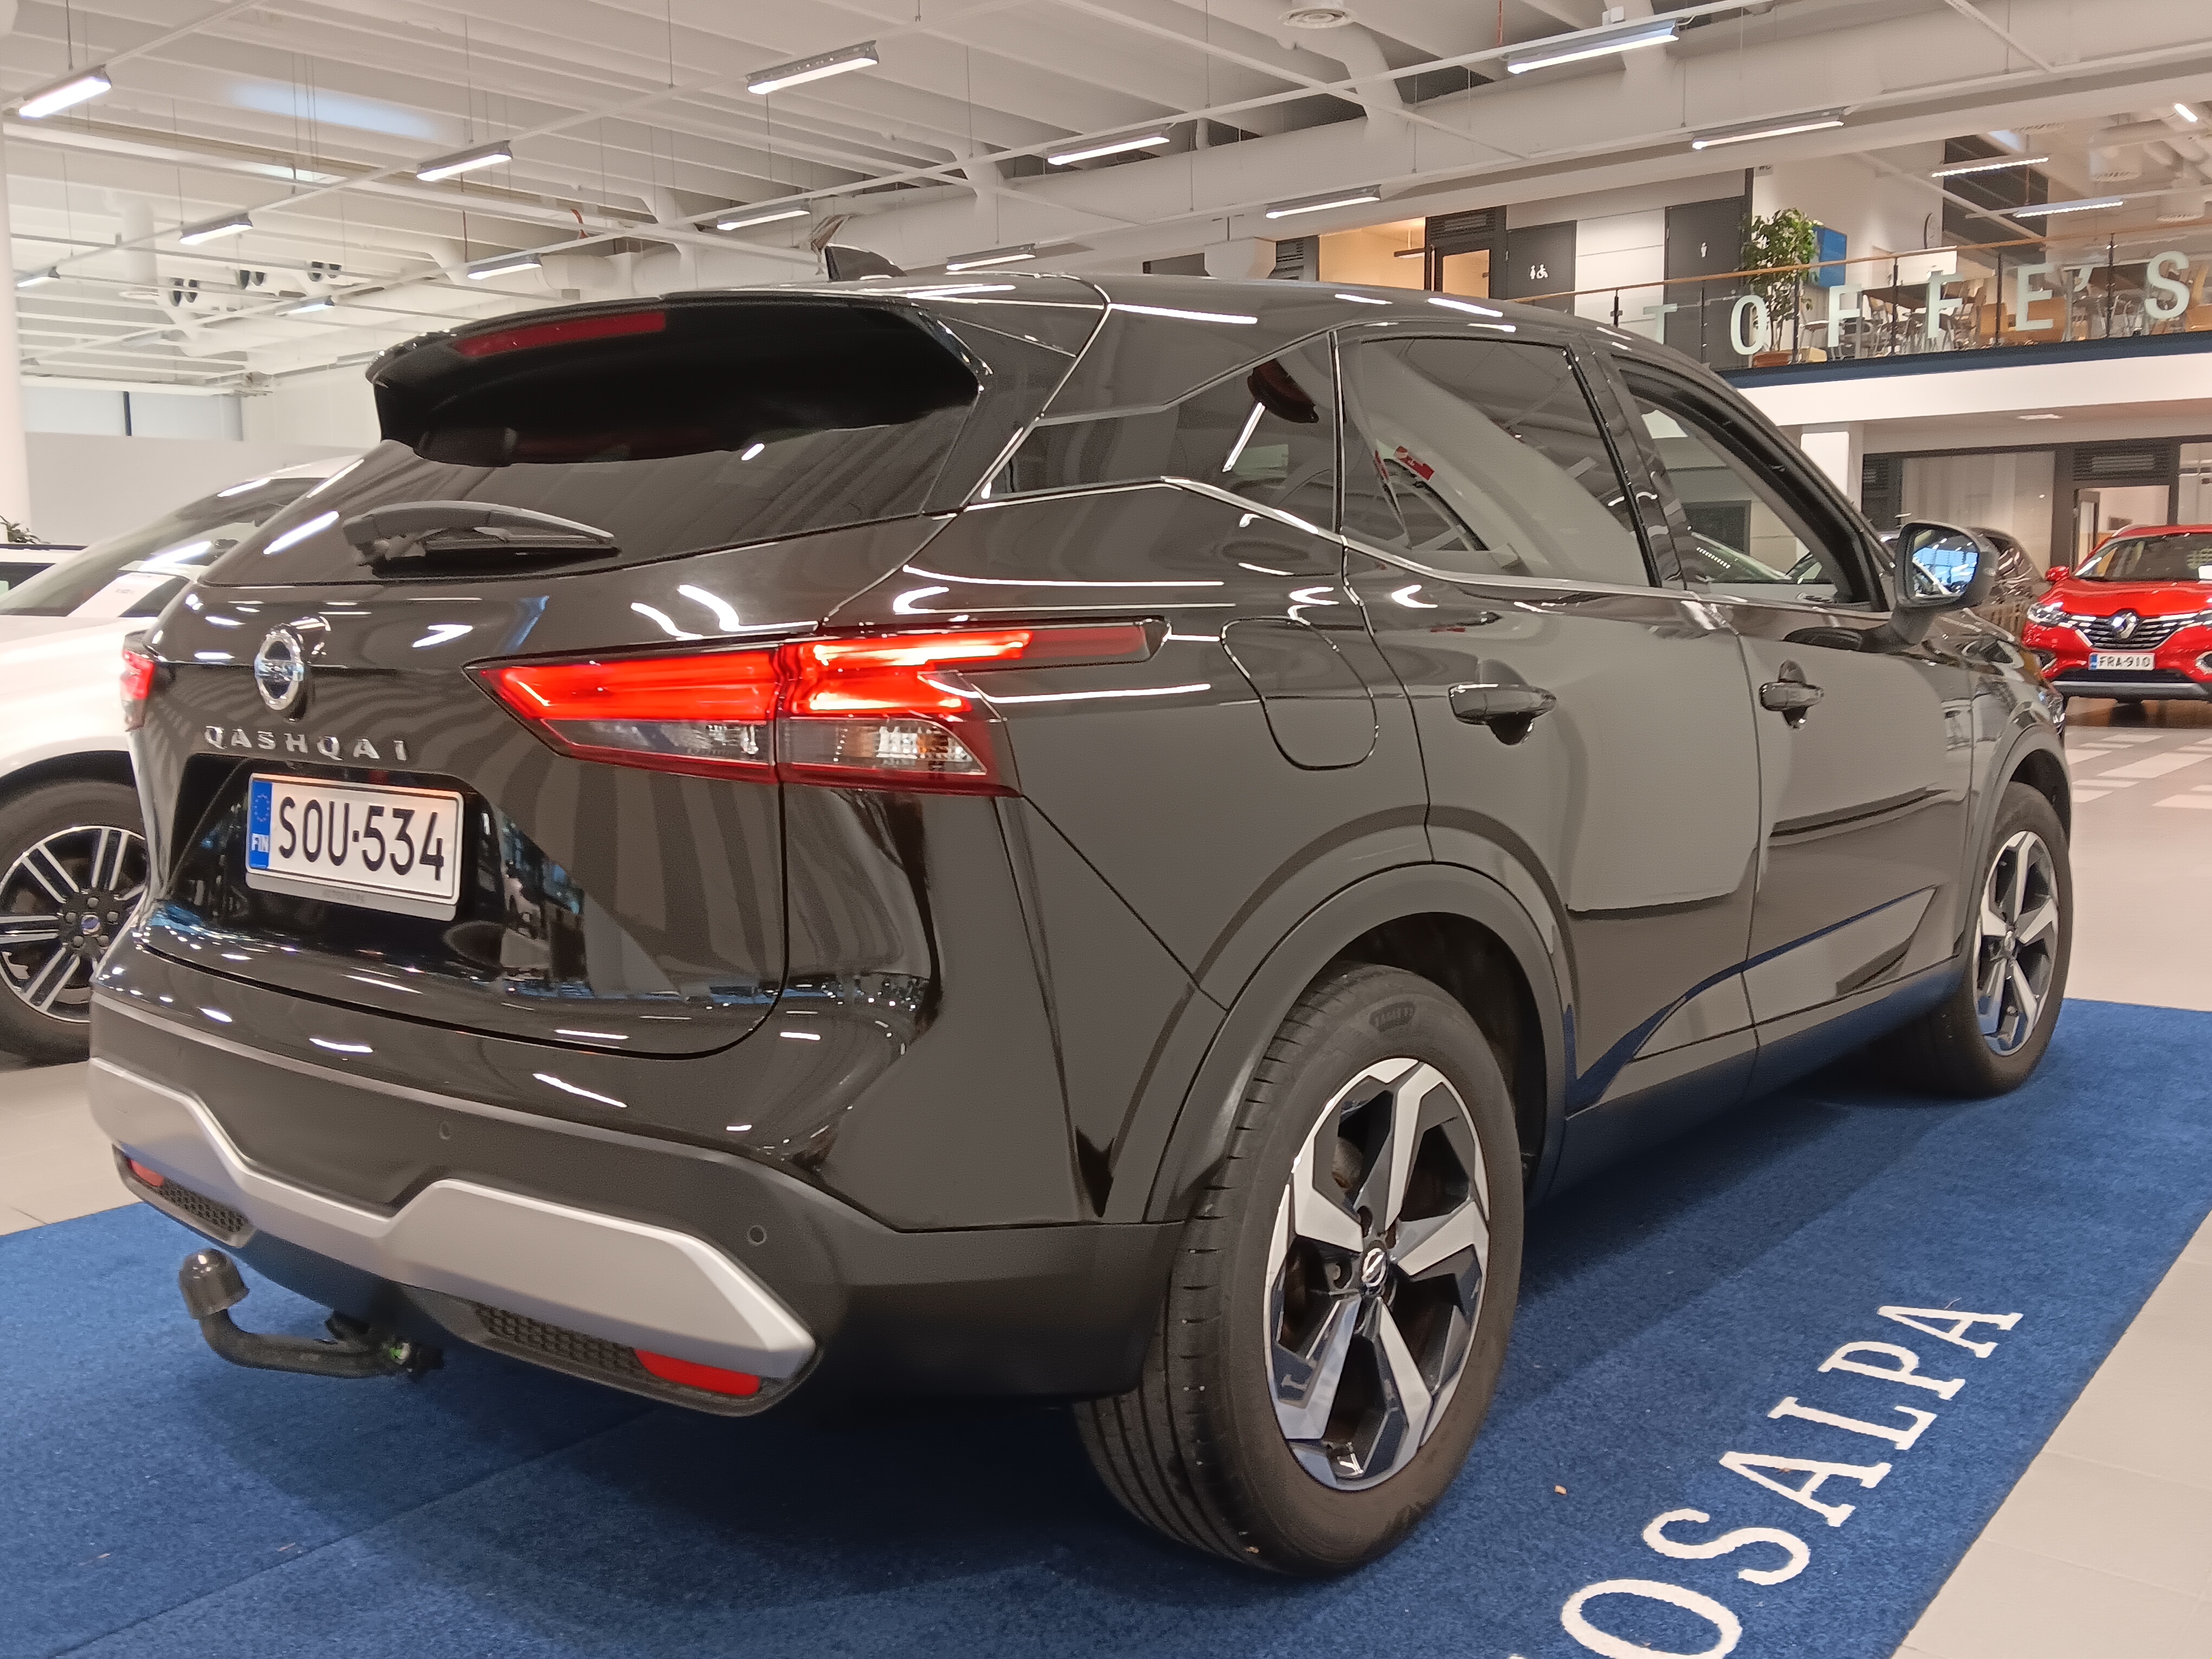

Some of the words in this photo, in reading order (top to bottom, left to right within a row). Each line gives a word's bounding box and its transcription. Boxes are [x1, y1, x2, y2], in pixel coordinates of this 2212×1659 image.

[204, 725, 407, 761] QASHQAI
[279, 796, 444, 881] SOU-534
[1509, 1305, 2023, 1659] OSALPA
